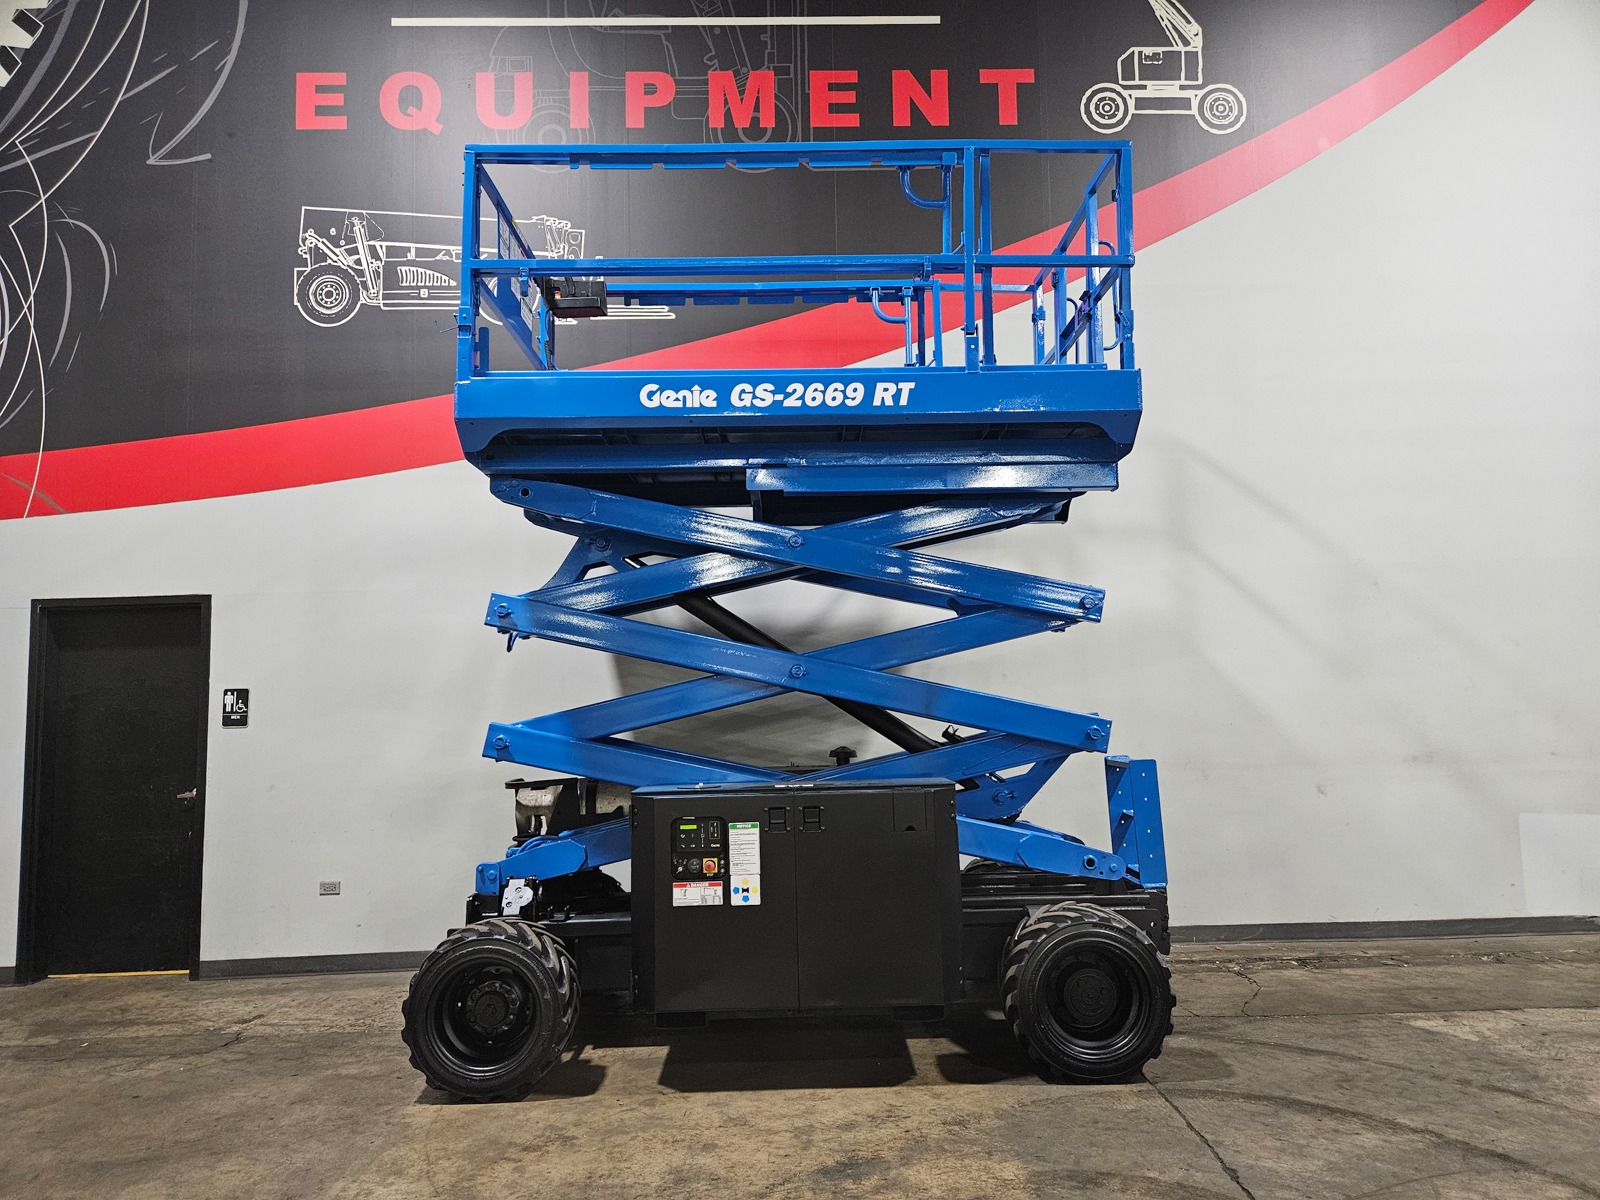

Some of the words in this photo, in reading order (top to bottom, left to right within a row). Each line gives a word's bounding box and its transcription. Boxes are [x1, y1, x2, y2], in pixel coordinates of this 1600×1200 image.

[295, 69, 1035, 134] EQUIPMENT
[639, 384, 717, 408] Genie
[730, 382, 864, 407] GS-2669
[873, 382, 916, 406] RT
